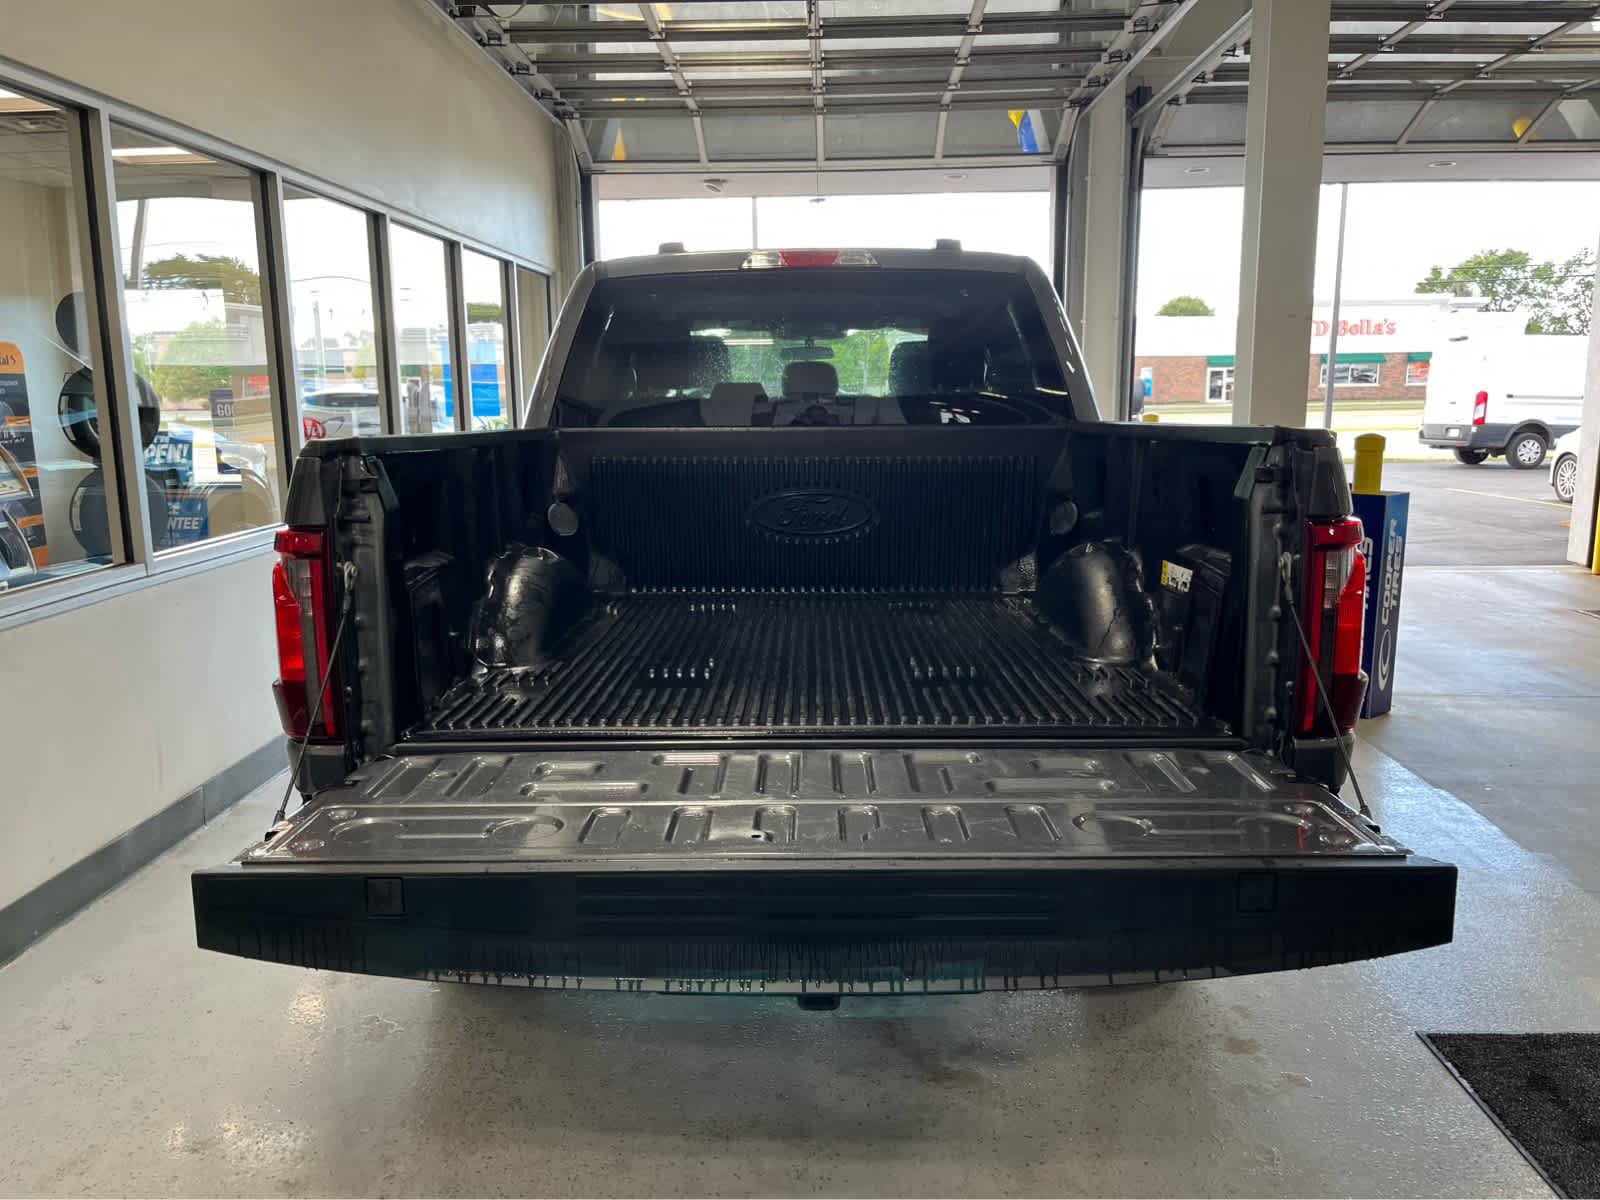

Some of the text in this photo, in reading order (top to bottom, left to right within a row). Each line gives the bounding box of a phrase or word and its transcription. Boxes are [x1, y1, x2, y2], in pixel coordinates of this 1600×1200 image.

[1312, 318, 1396, 336] DBella's
[144, 443, 190, 464] PEN!
[776, 496, 849, 527] Ford
[1382, 518, 1398, 625] COOPER
[1390, 535, 1403, 610] TIRES
